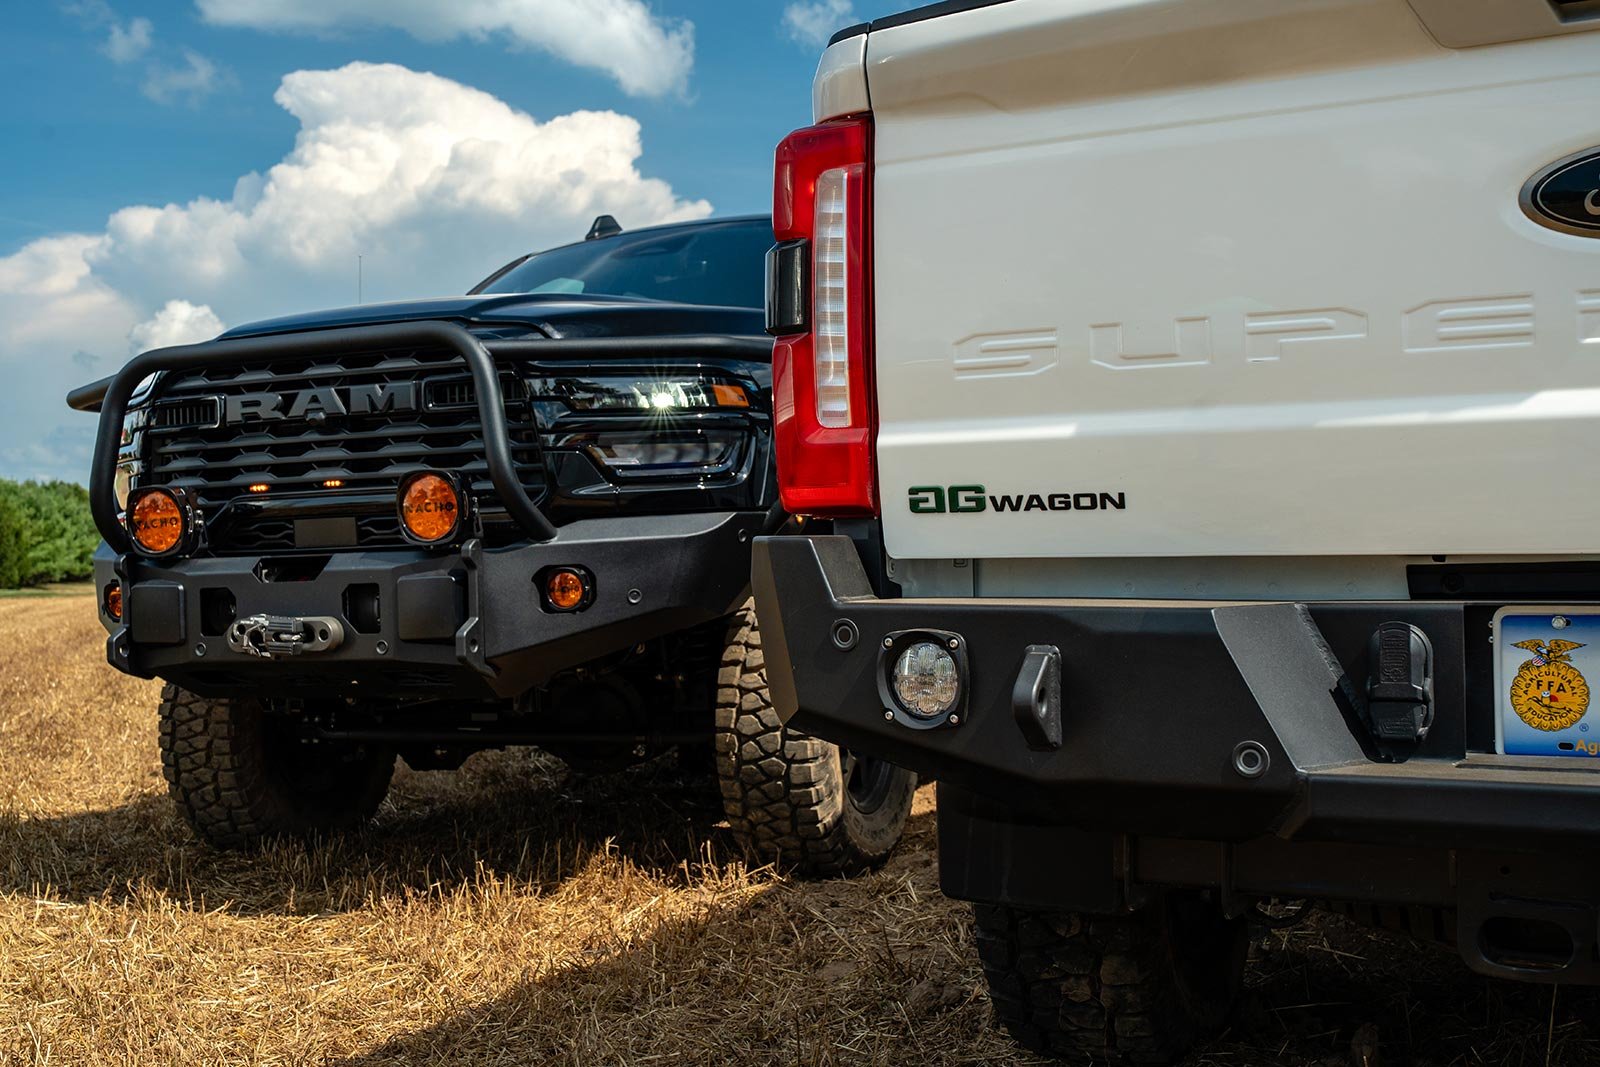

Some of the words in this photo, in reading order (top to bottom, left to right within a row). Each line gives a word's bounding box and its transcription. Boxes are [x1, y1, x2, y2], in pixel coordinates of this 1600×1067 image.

[953, 289, 1600, 380] SUPE
[227, 382, 417, 424] RAM
[989, 492, 1126, 512] WAGON
[1523, 670, 1578, 697] AGRICULTURAL
[1536, 680, 1567, 693] FFA
[1527, 707, 1573, 721] EDUCATION
[1575, 739, 1600, 756] Ag
